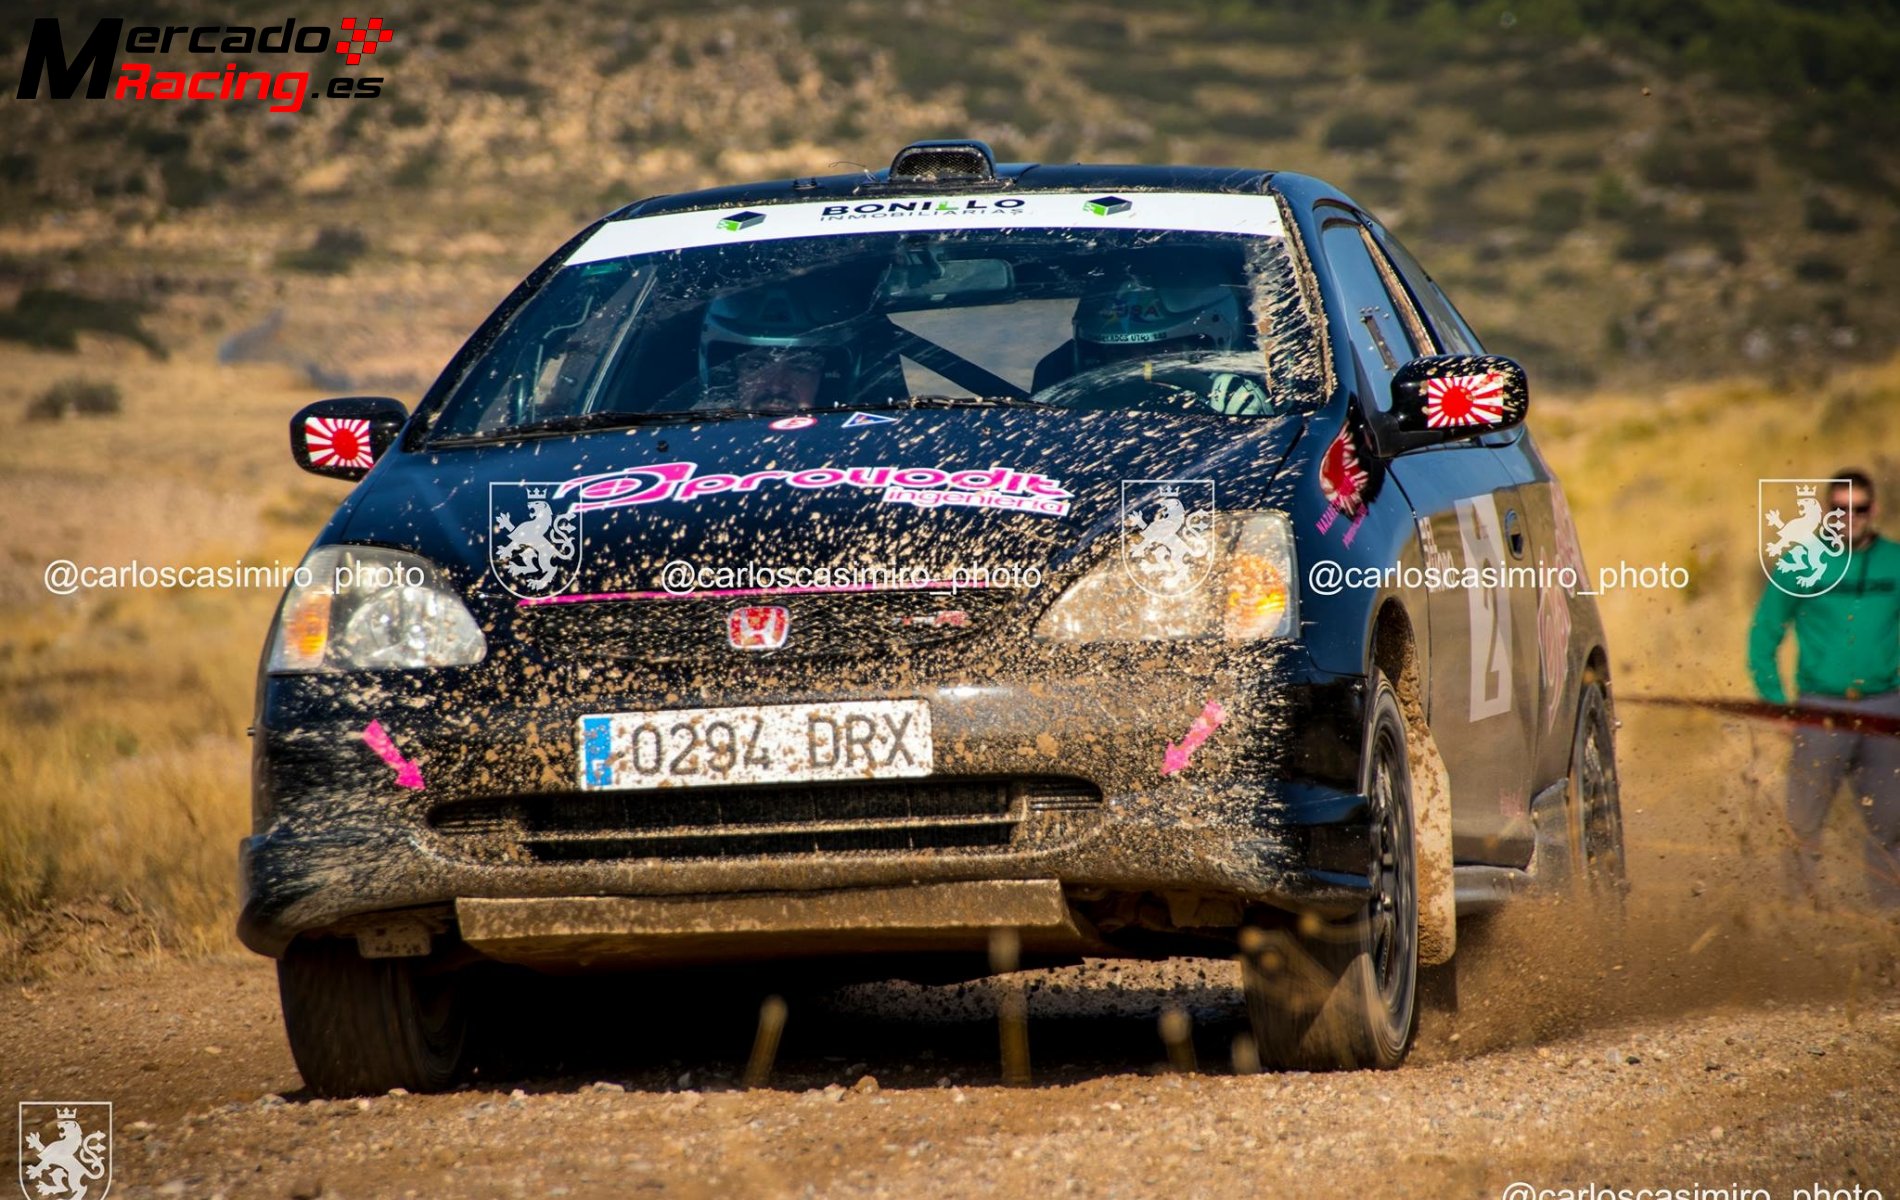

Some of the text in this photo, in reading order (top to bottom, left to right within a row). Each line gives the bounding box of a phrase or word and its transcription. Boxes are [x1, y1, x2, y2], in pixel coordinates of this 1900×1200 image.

[822, 198, 1026, 216] BONILLO
[631, 715, 771, 776] 0294
[807, 711, 915, 769] DRX
